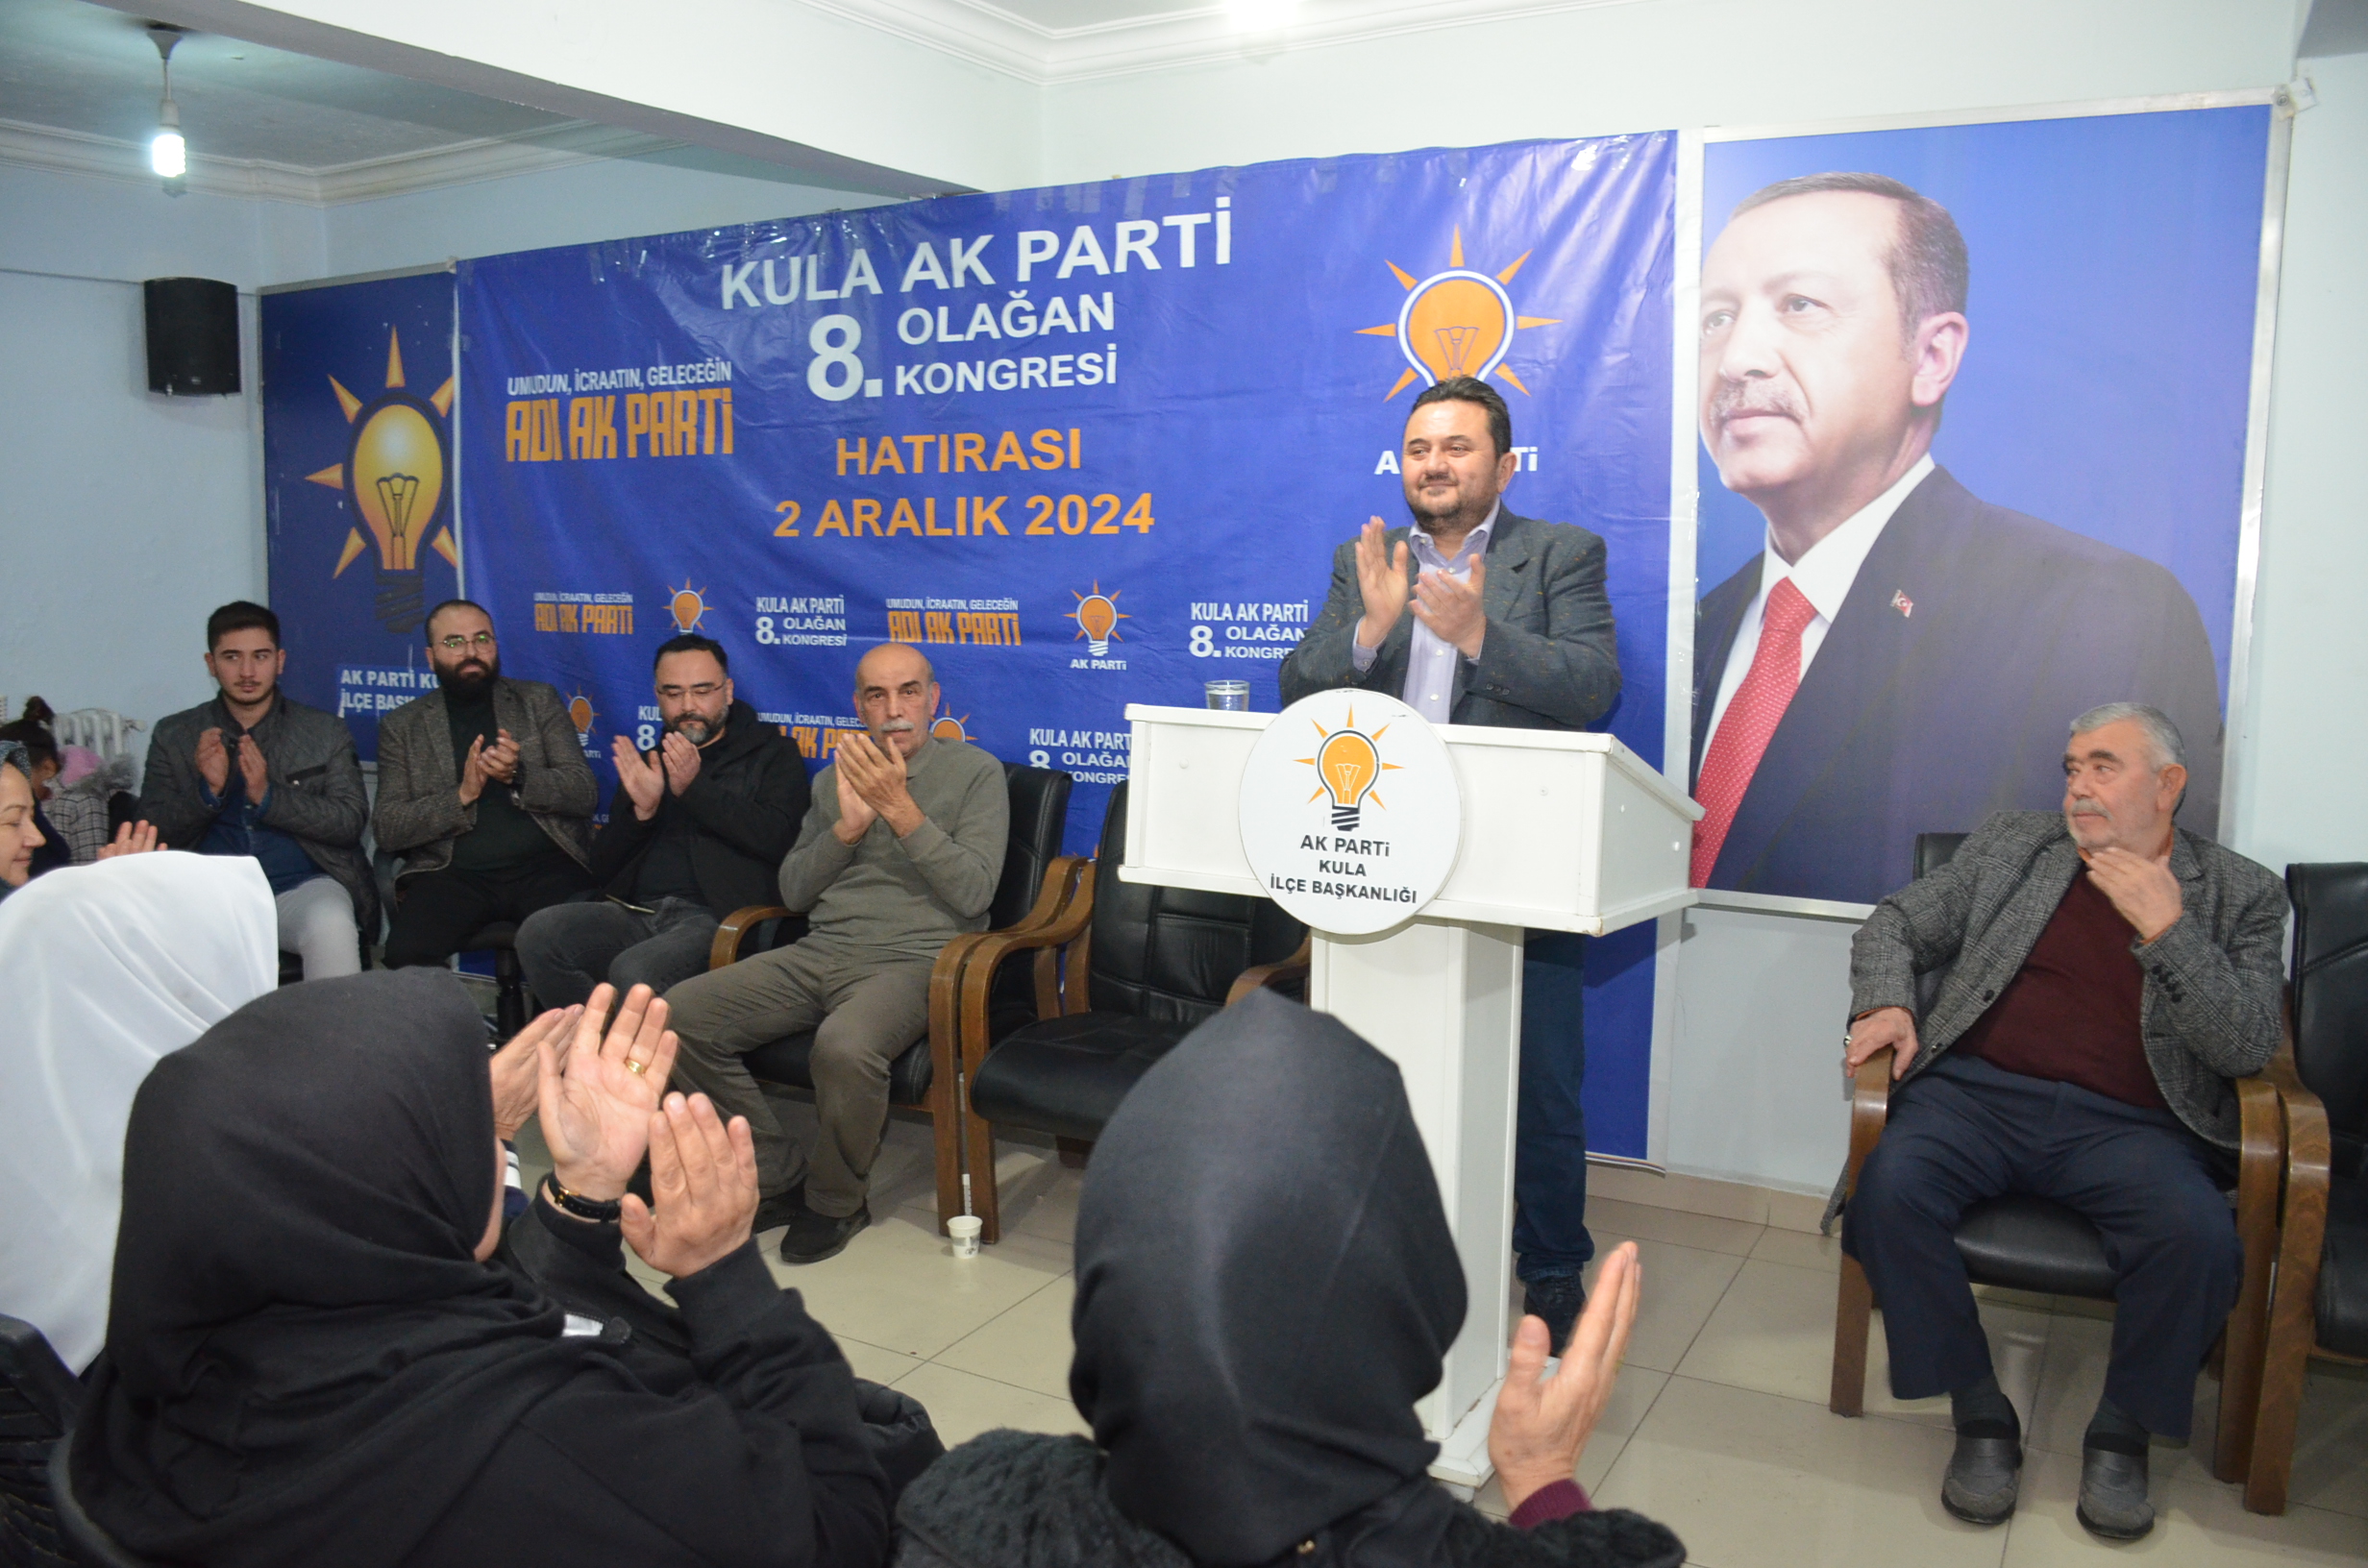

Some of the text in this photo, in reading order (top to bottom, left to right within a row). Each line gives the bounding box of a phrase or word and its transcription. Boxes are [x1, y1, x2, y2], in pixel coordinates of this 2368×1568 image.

[722, 196, 1230, 309] KULA AK PARTİ
[898, 290, 1114, 345] OLAĞAN
[807, 314, 882, 402] 8.
[896, 344, 1117, 396] KONGRESİ
[507, 357, 731, 395] UMUDUN, İCRAATIN, GELECEĞİN
[506, 398, 563, 461] ADI
[570, 395, 617, 459] AK
[837, 429, 1080, 476] HATIRASI
[774, 493, 1154, 537] 2 ARALIK 2024
[756, 597, 789, 613] KULA
[790, 598, 808, 613] AK
[1191, 599, 1308, 623] KULA AK PARTİ
[755, 616, 780, 645] 8.
[783, 615, 846, 630] OLAĞAN
[888, 611, 923, 643] ADI
[925, 611, 955, 644] AK
[782, 634, 847, 646] KONGRESİ
[1189, 625, 1221, 657] 8.
[1070, 658, 1089, 670] AK
[340, 670, 363, 685] AK
[419, 673, 440, 689] KU
[340, 688, 373, 712] İLÇE
[638, 705, 663, 722] KUL
[636, 724, 655, 750] 8
[1029, 727, 1132, 750] KULA AK PART
[1062, 750, 1131, 769] OLAĞA
[1300, 835, 1328, 851] AK
[1319, 859, 1367, 876] KULA
[1270, 872, 1417, 903] İLÇE BAŞKANLIĞI
